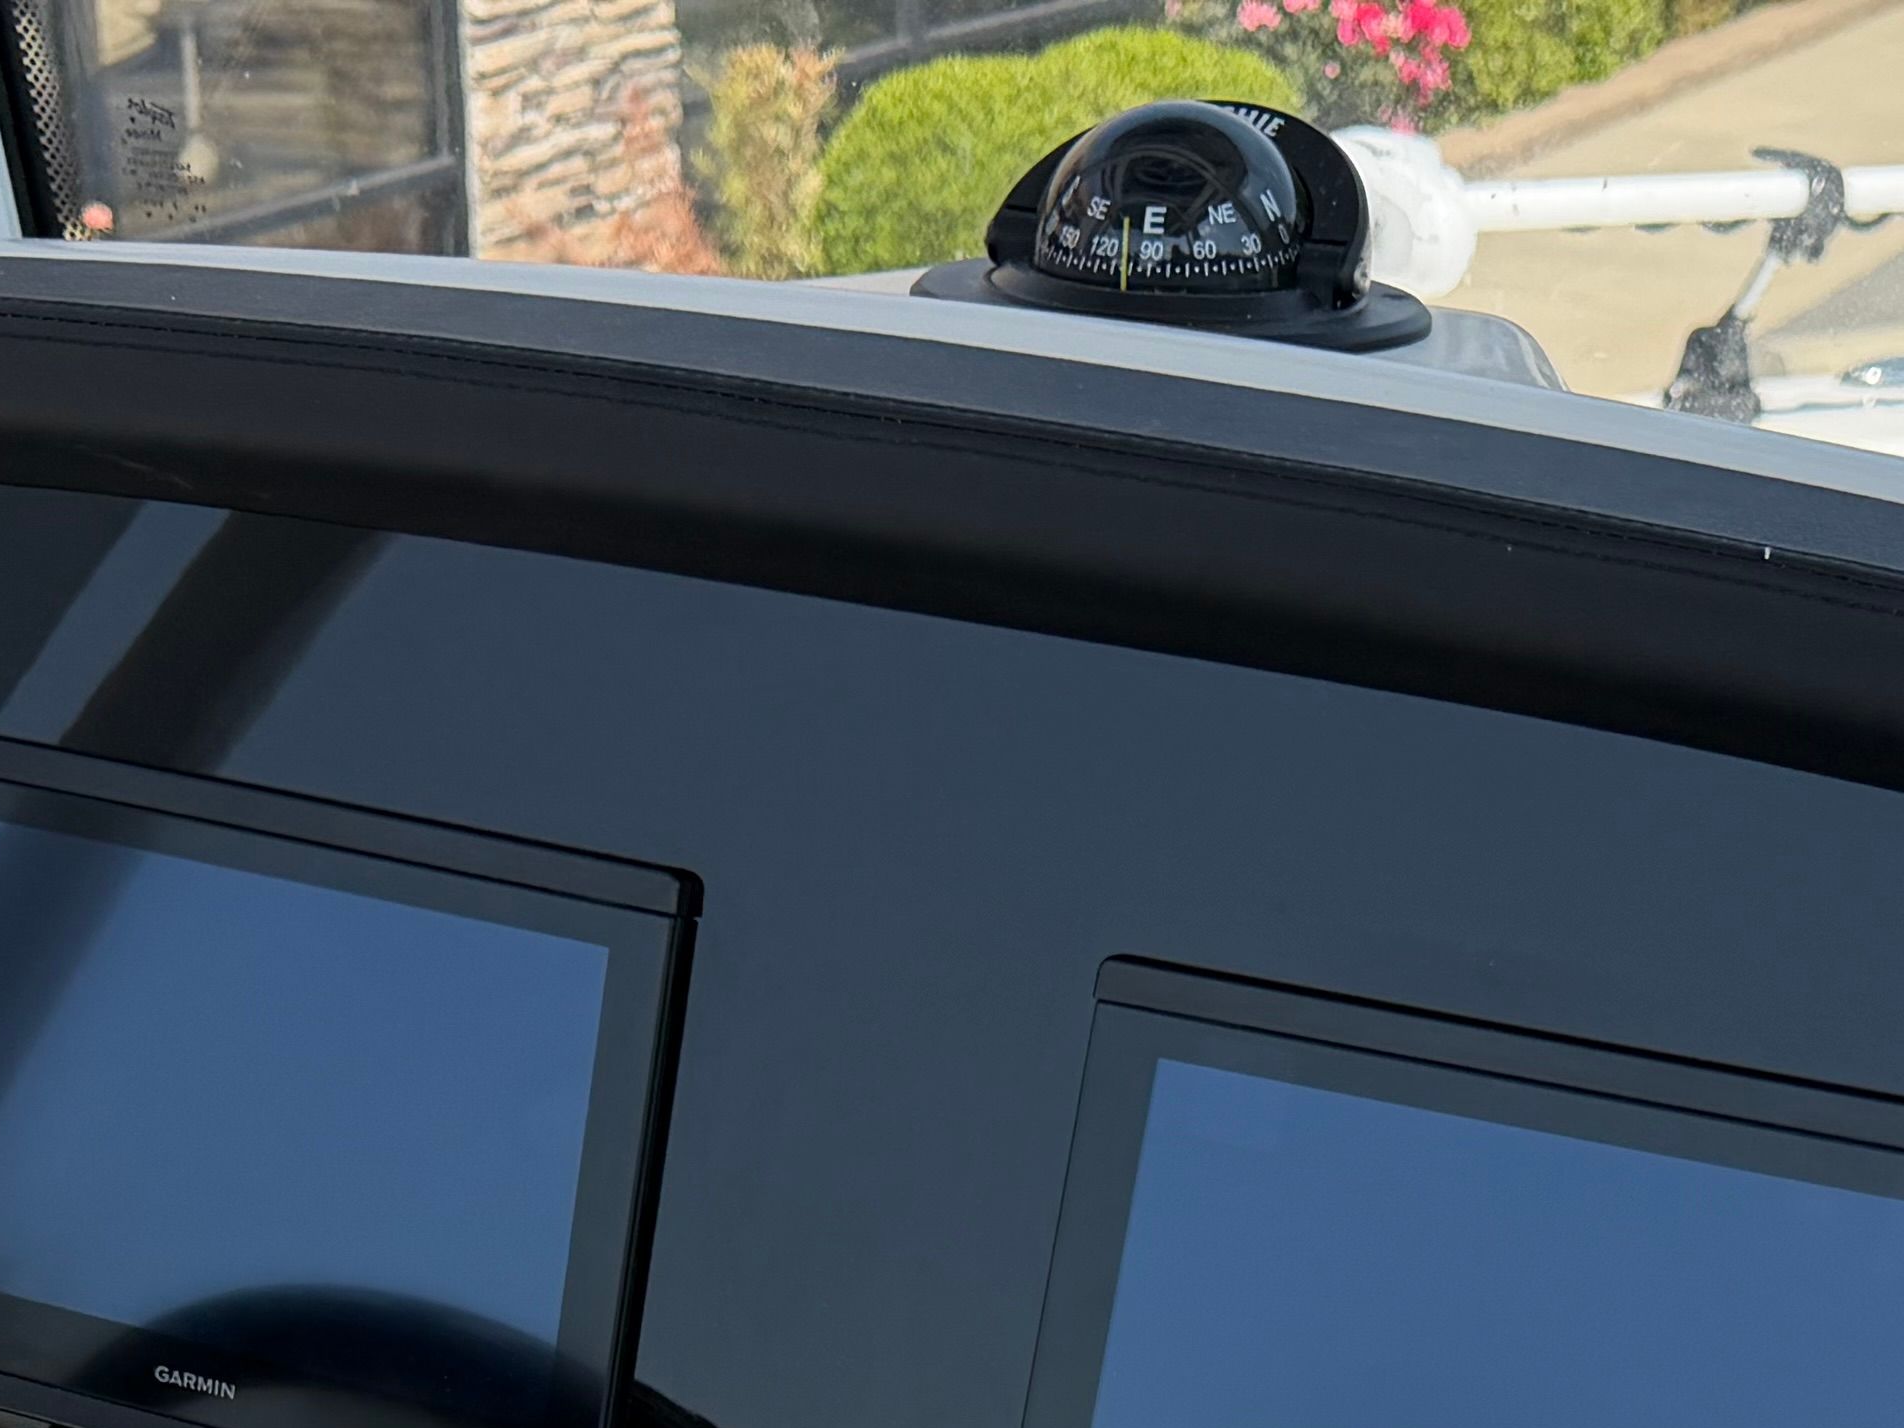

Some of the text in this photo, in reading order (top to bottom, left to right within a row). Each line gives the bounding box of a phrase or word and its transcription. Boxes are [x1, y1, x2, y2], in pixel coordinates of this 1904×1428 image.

[1143, 206, 1167, 234] E
[1208, 202, 1236, 225] NE
[1260, 189, 1281, 222] N
[1090, 235, 1120, 257] 120
[1140, 240, 1165, 261] 90
[1193, 239, 1217, 260] 60
[1241, 233, 1262, 254] 30
[154, 1365, 236, 1400] GARMIN
